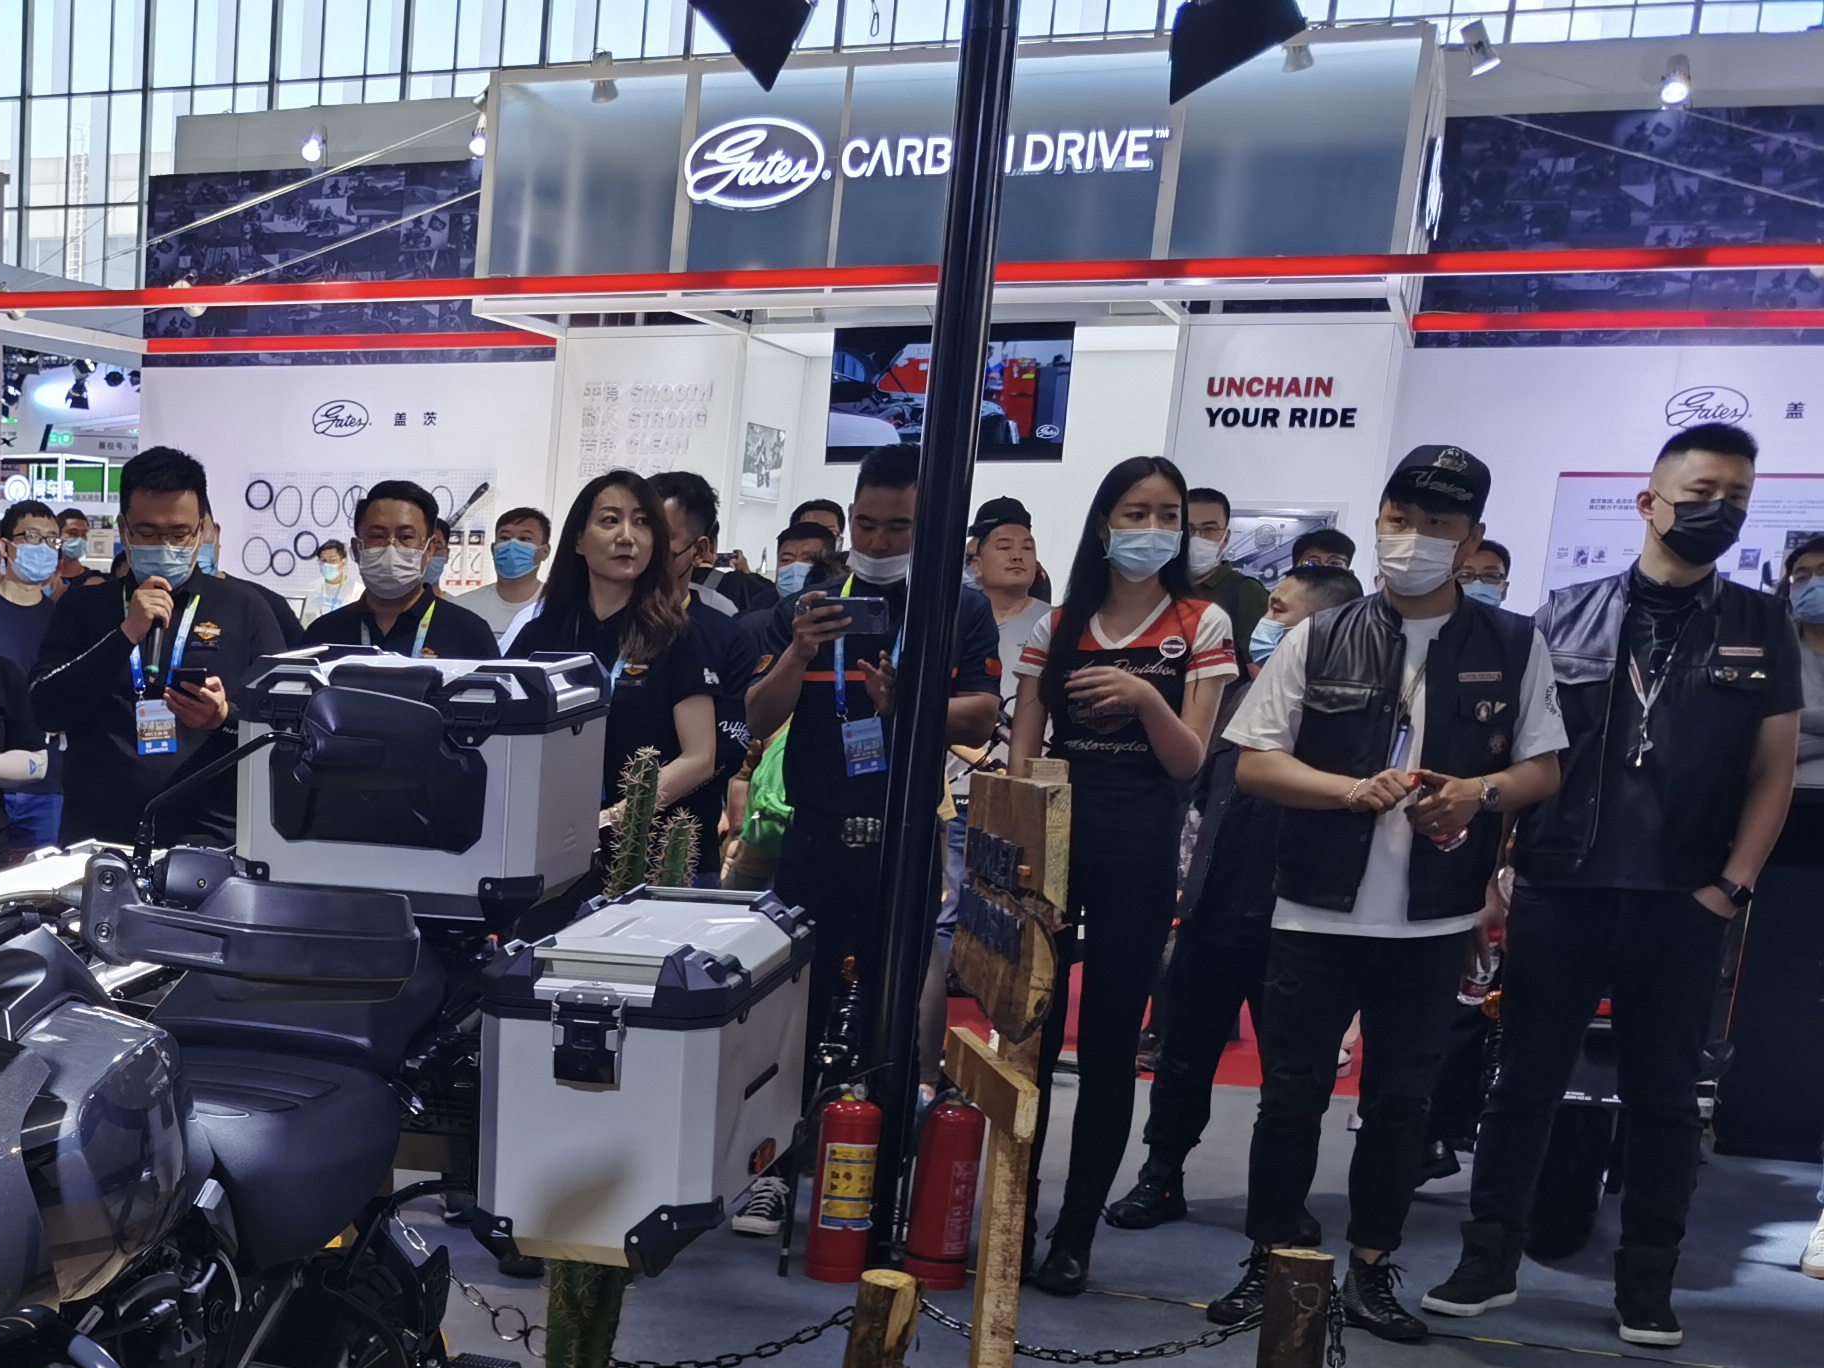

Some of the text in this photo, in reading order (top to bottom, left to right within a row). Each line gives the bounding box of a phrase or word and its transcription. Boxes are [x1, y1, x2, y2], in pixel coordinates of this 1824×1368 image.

[693, 128, 811, 202] Gates
[630, 380, 715, 403] SMOOTH
[1205, 375, 1334, 398] UNCHAIN
[628, 406, 707, 429] STRONG
[1204, 406, 1358, 429] YOUR RIDE
[1784, 401, 1806, 419] 盖
[626, 433, 690, 455] CLEAN
